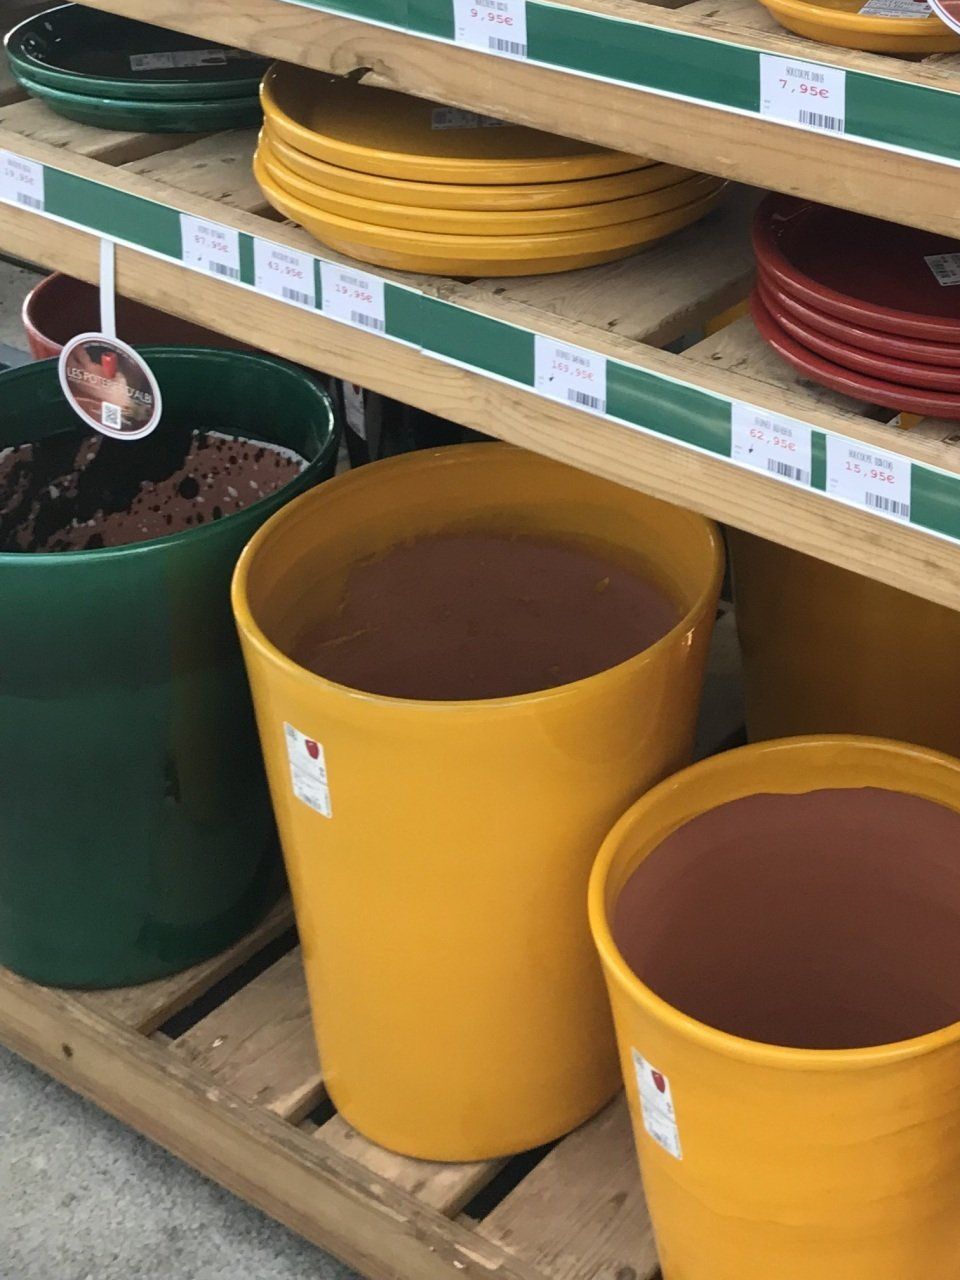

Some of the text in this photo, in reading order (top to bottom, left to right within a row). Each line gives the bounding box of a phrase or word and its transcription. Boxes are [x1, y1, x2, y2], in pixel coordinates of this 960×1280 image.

[470, 8, 514, 26] 9,95€
[779, 79, 830, 98] 7,95€
[67, 367, 82, 380] LES
[845, 461, 896, 485] 15,95€
